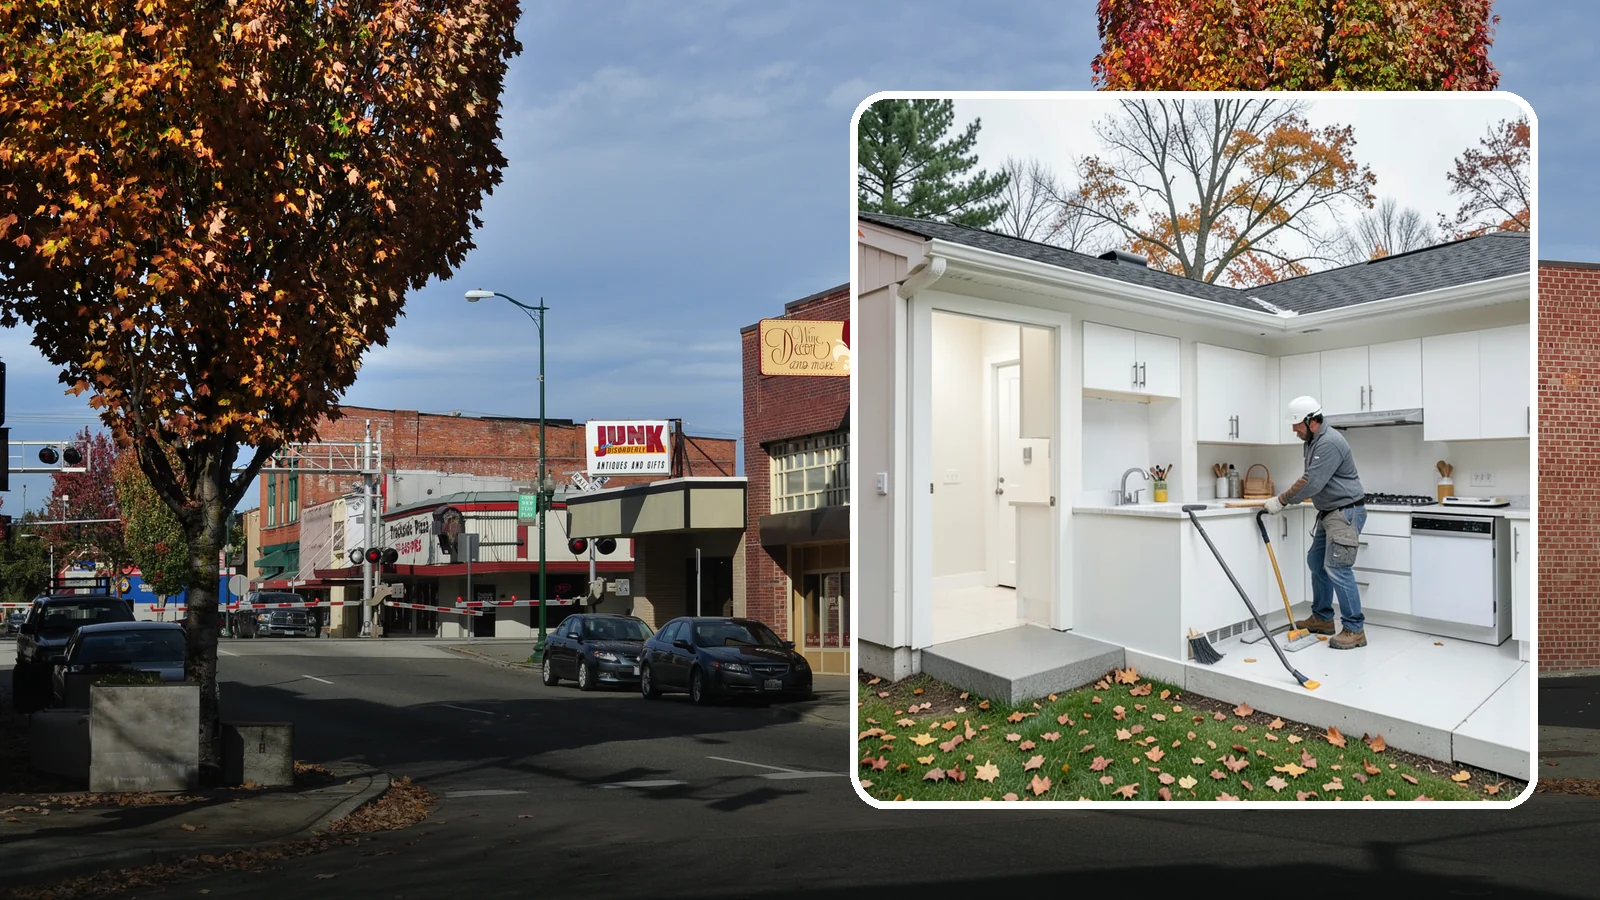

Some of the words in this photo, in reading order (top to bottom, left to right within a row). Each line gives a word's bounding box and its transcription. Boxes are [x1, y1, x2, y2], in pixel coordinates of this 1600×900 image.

[595, 425, 665, 457] JUNK
[607, 446, 646, 454] DISORDERLY
[597, 461, 628, 470] ANTIQUES
[631, 461, 644, 469] AND
[646, 460, 665, 469] GIFTS
[414, 519, 429, 534] Pizza
